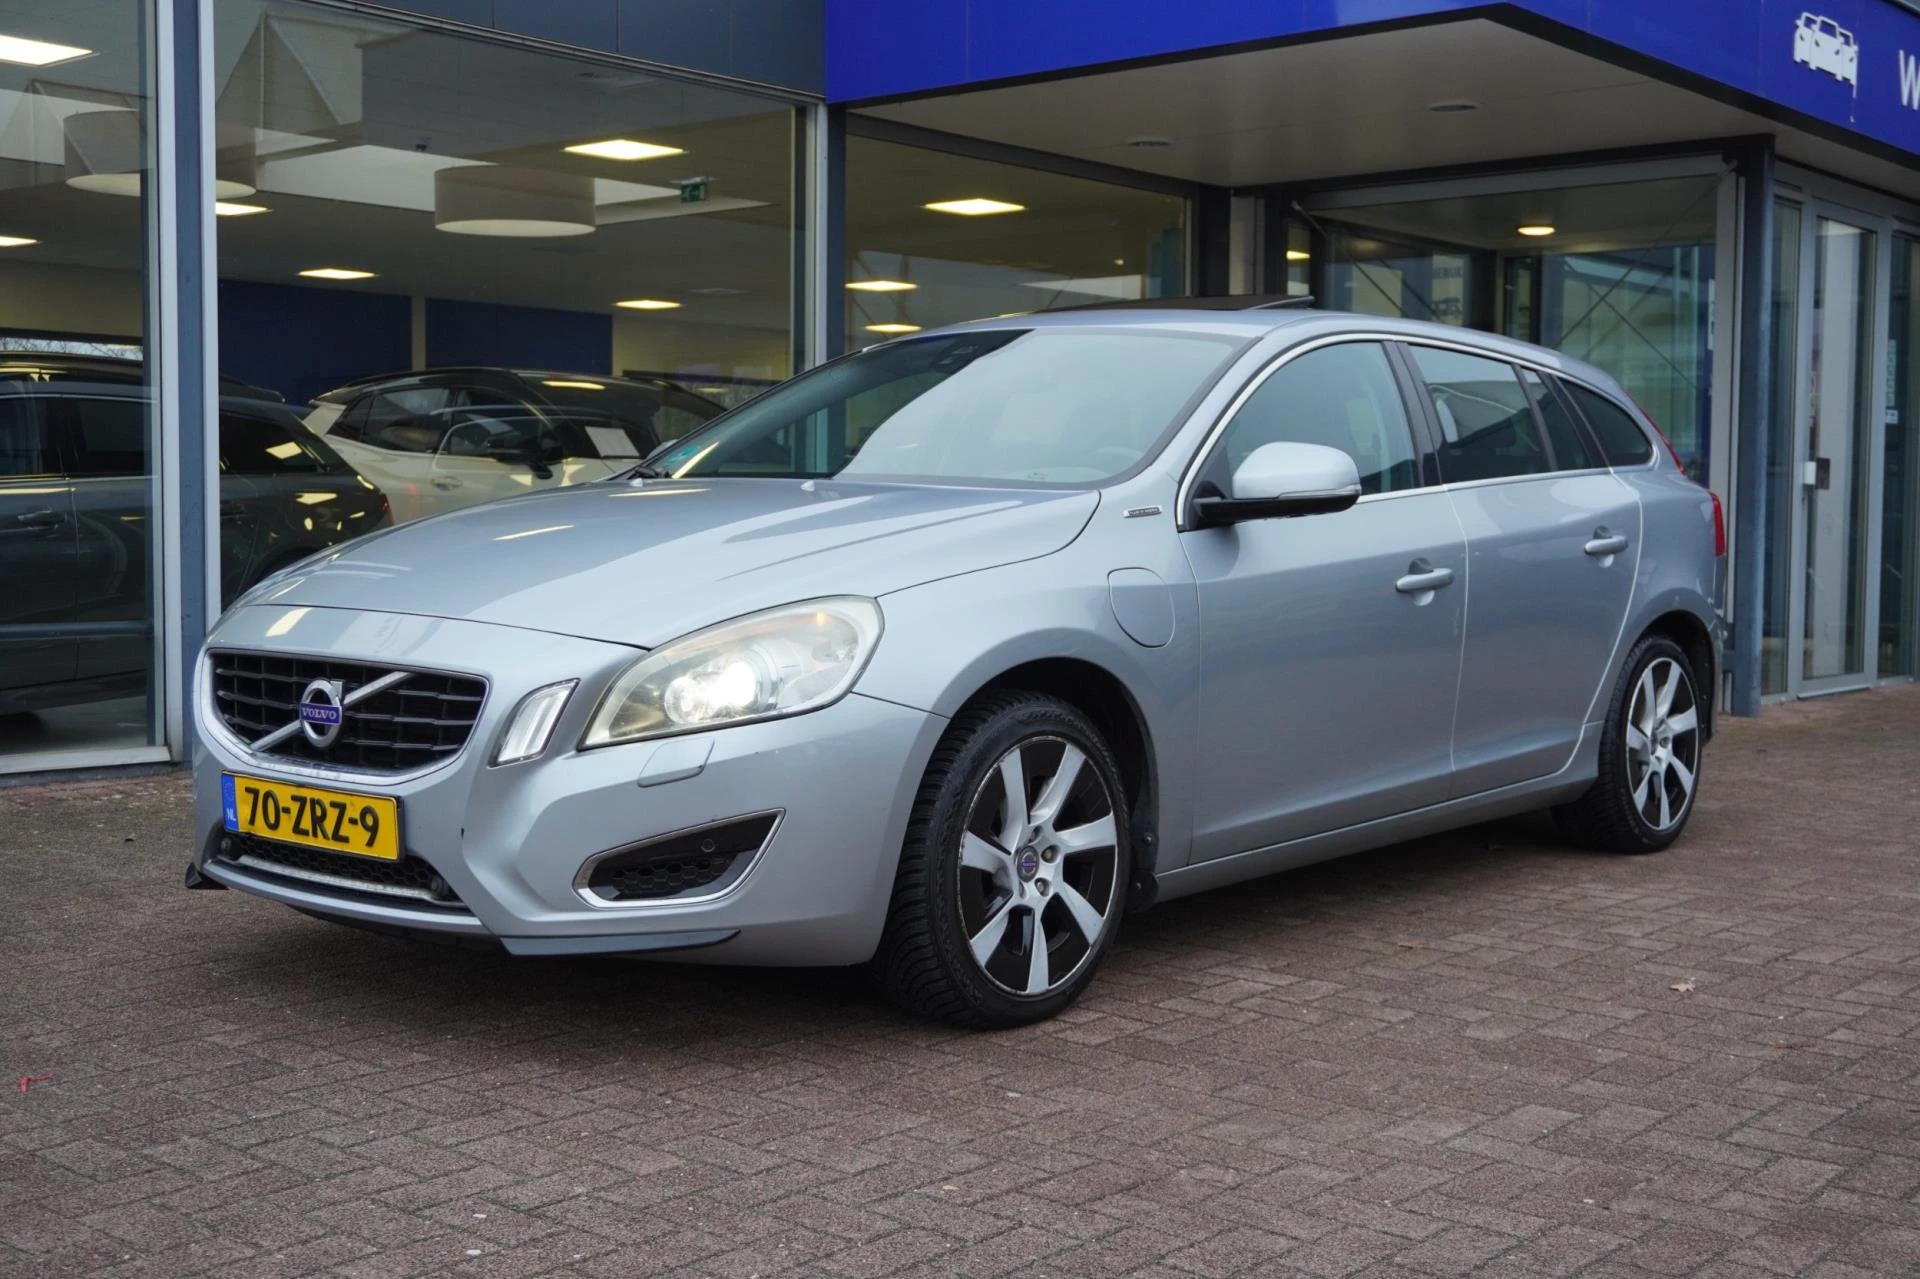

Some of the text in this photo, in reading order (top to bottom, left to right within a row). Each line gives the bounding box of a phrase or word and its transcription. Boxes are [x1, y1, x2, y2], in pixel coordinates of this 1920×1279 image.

[302, 707, 337, 720] VOLVO
[226, 807, 237, 821] NL
[244, 787, 380, 847] 70-ZRZ-9
